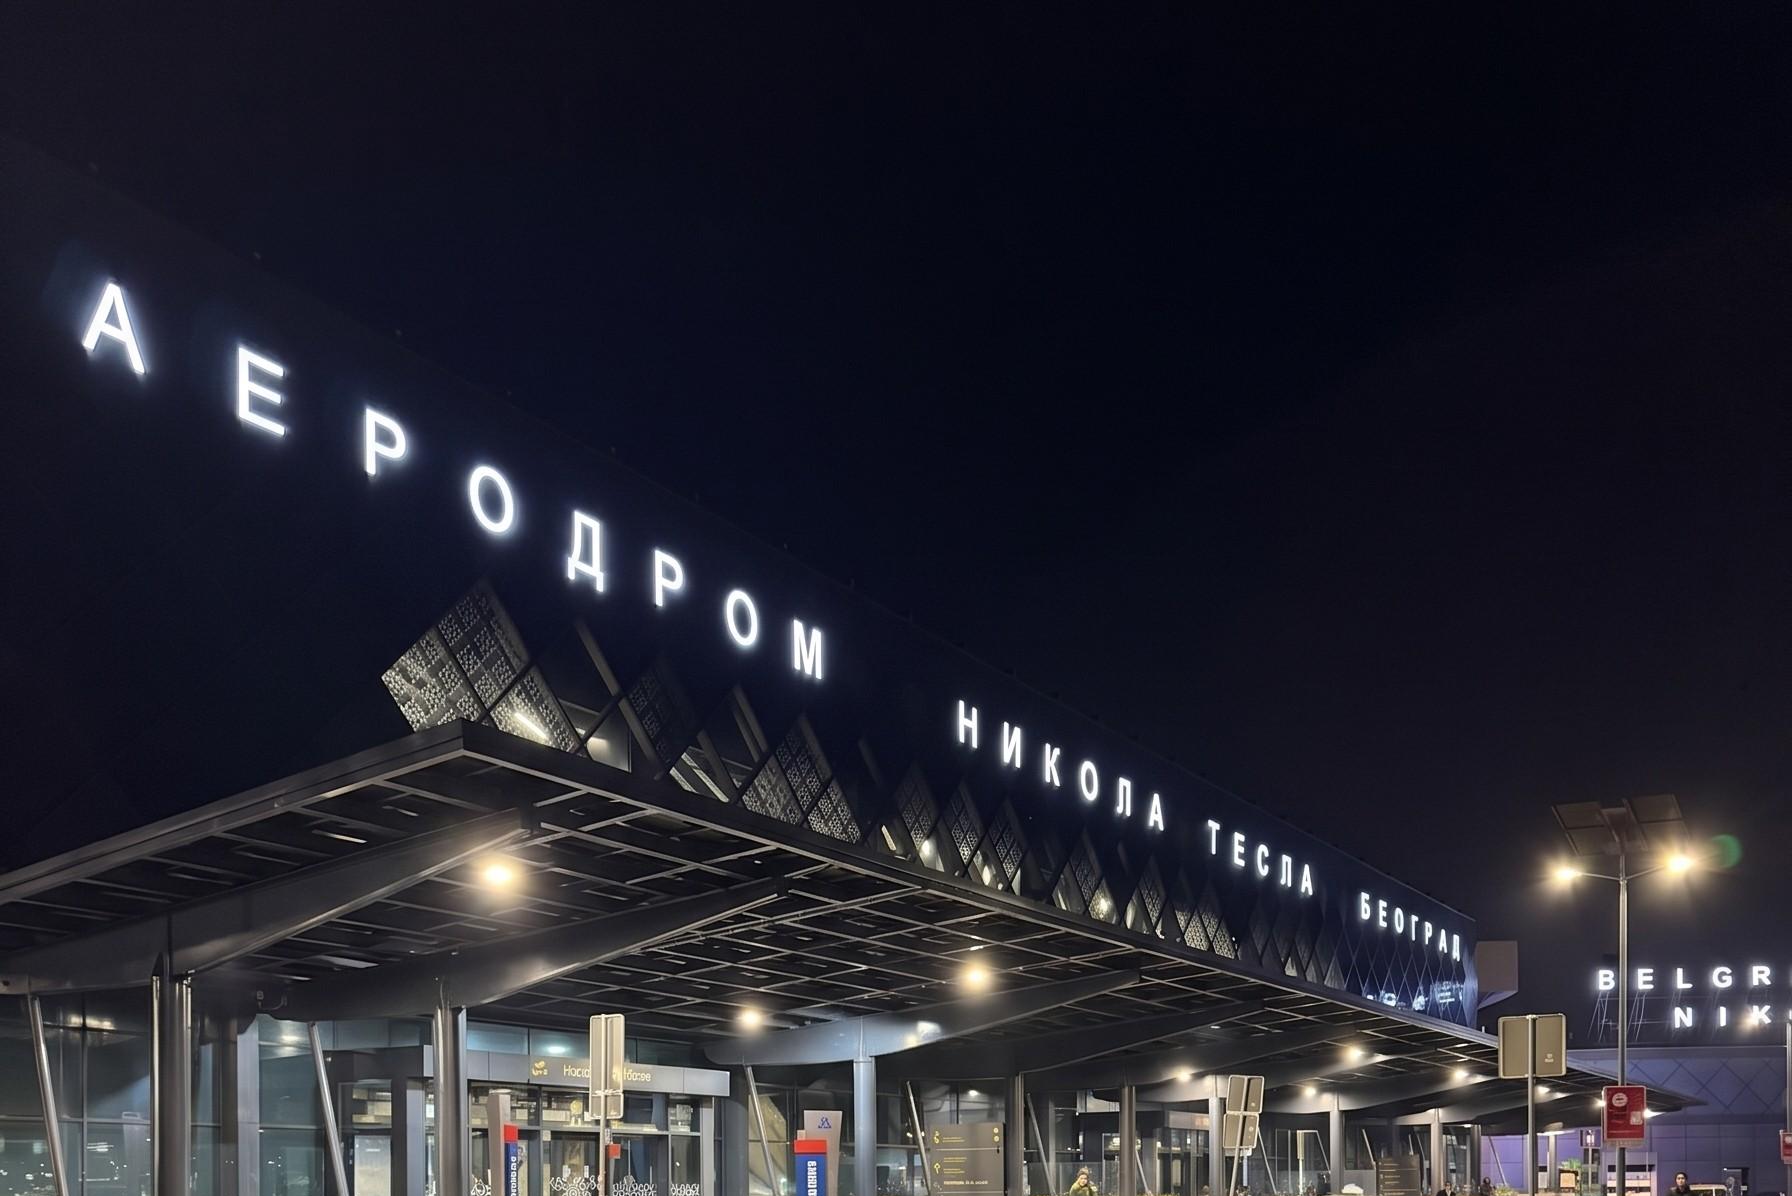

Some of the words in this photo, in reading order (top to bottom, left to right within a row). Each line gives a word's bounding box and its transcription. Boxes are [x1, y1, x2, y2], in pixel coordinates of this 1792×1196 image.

[81, 280, 824, 680] АЕРОДРОМ
[956, 699, 1166, 832] НИКОЛА
[1207, 819, 1314, 896] ТЕСЛА
[1360, 891, 1461, 962] БЕОГРАД
[1673, 1005, 1792, 1029] NIK
